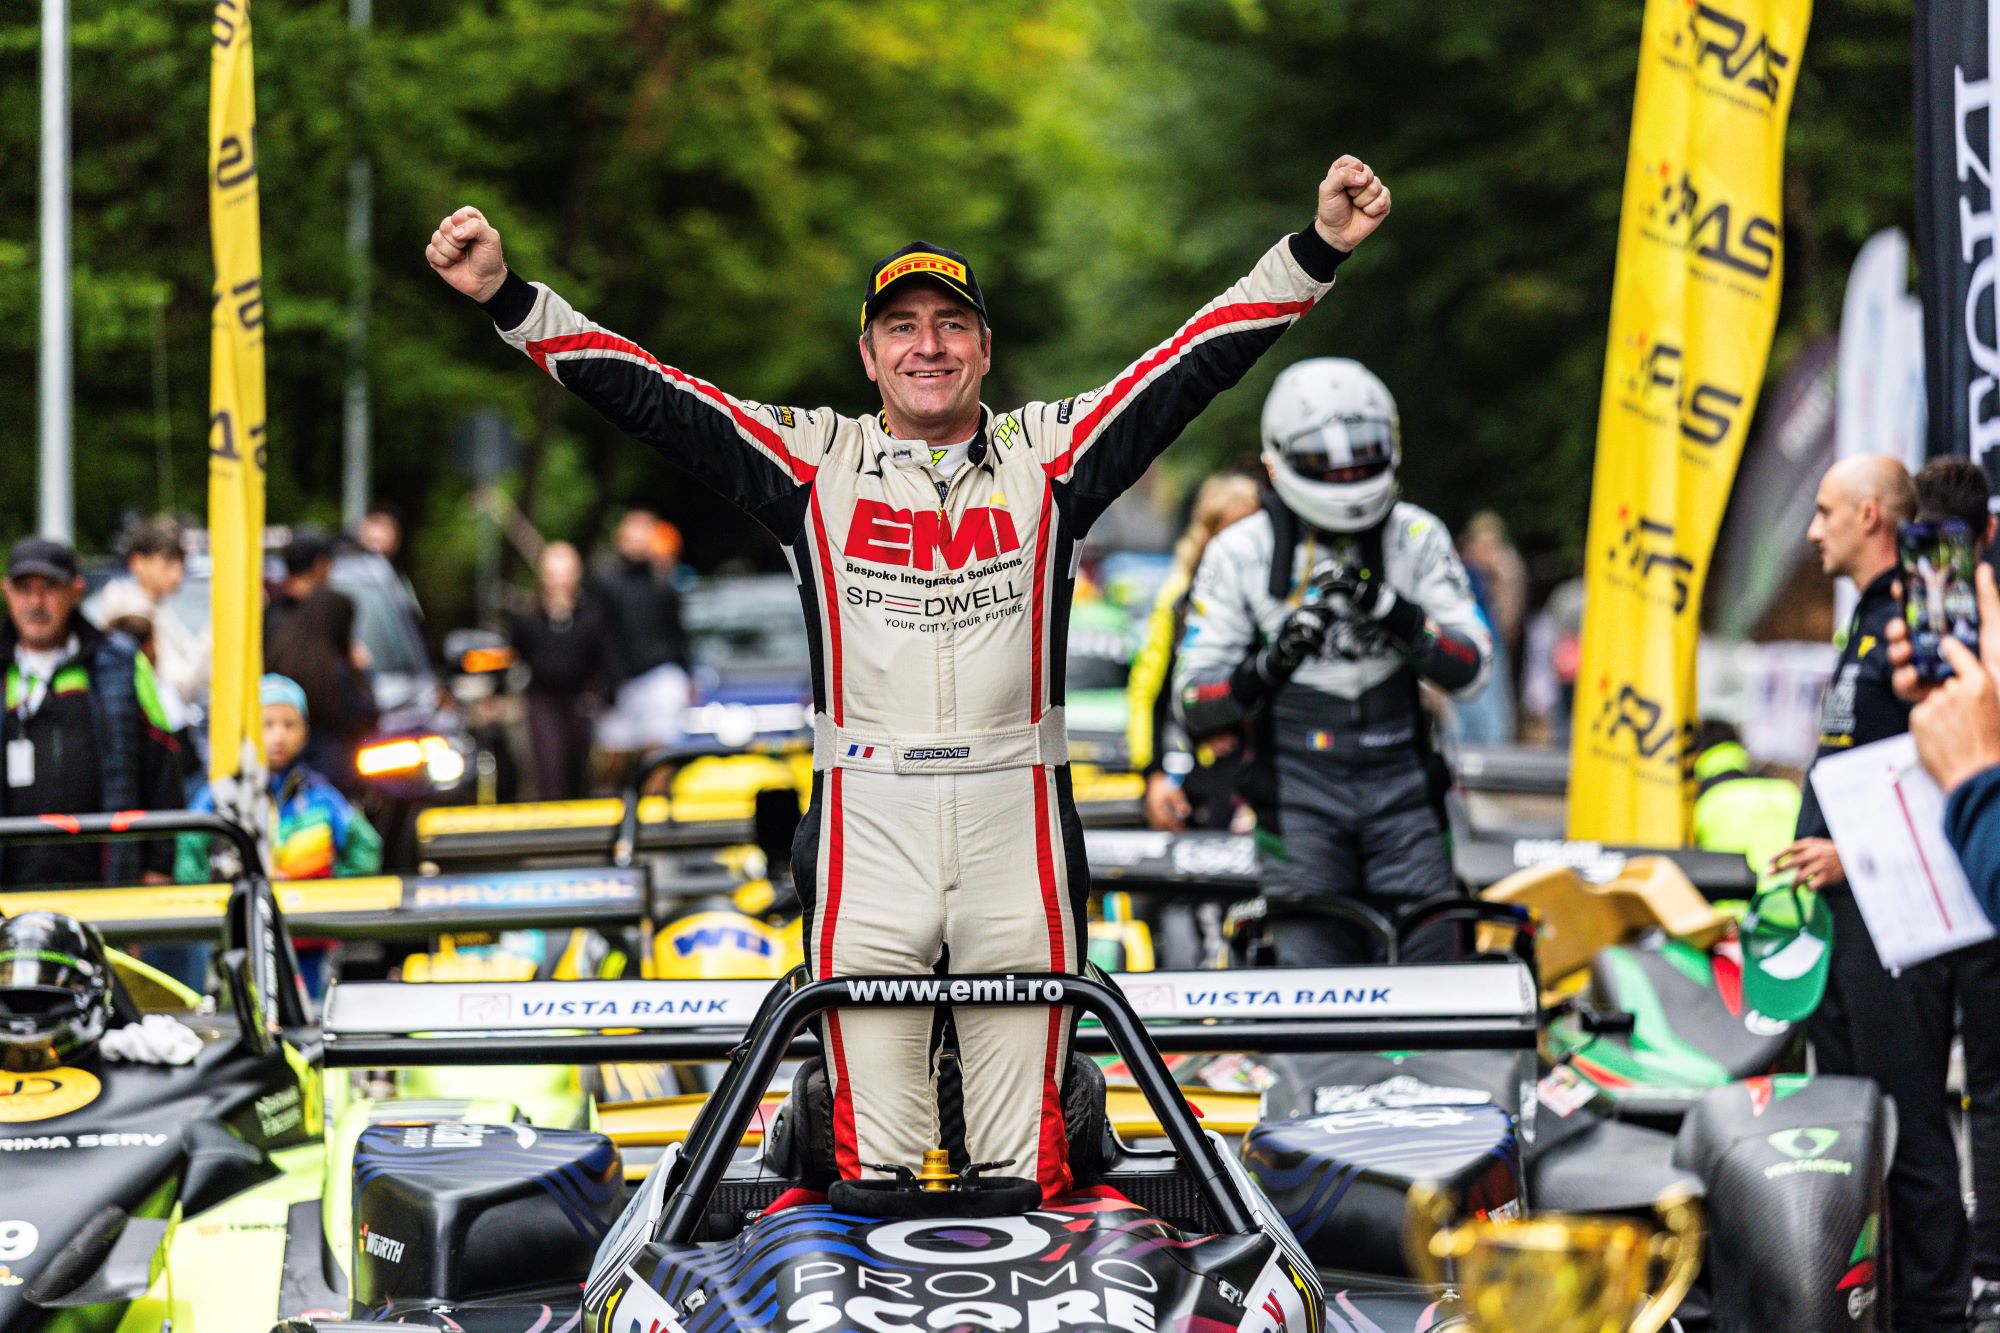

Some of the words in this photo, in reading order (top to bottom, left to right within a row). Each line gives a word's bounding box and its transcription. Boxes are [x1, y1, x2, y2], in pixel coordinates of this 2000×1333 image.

[880, 257, 960, 287] PIRELLI
[844, 498, 1020, 571] EMI
[846, 562, 897, 582] Bespoke
[901, 573, 965, 588] Integrated
[968, 557, 1023, 580] Solutions
[885, 618, 915, 631] YOUR
[953, 616, 981, 630] YOUR
[986, 604, 1023, 622] FUTURE
[904, 748, 970, 759] JEROME
[846, 975, 1064, 1001] www.emi.ro
[1185, 990, 1281, 1006] VISTA
[1294, 988, 1393, 1004] BANK
[522, 1001, 618, 1016] VISTA
[630, 999, 730, 1014] BANK
[77, 1133, 168, 1147] SERV
[794, 1259, 1158, 1299] PROMO
